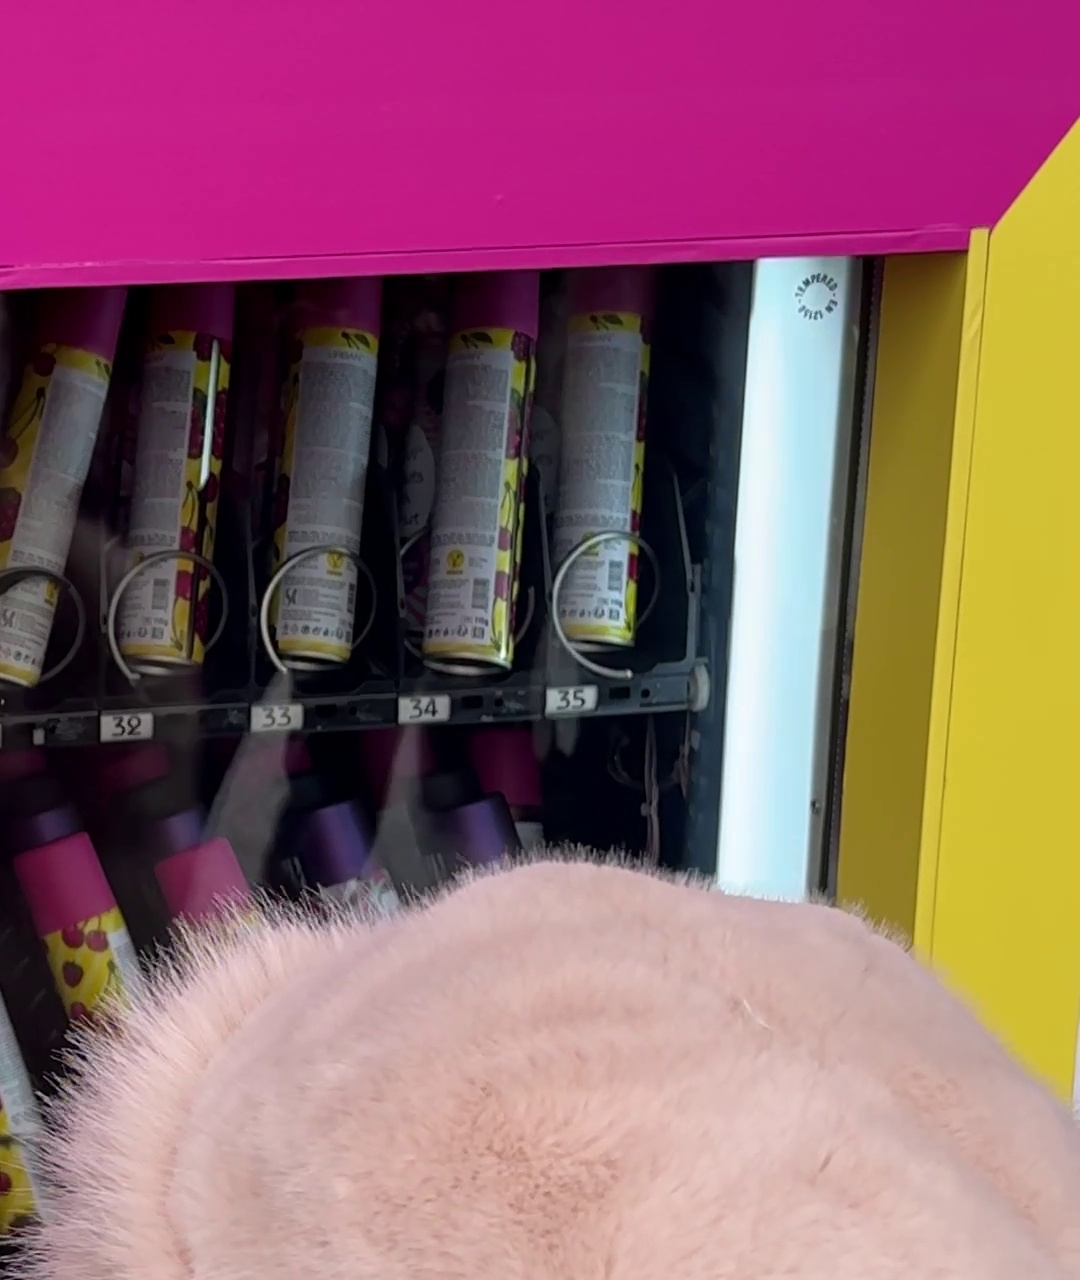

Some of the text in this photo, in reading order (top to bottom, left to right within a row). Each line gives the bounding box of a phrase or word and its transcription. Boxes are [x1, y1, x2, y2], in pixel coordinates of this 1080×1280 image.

[795, 273, 838, 297] TEMPERED
[825, 299, 838, 314] EN
[408, 697, 438, 719] 34
[556, 689, 586, 711] 35
[262, 706, 291, 728] 33
